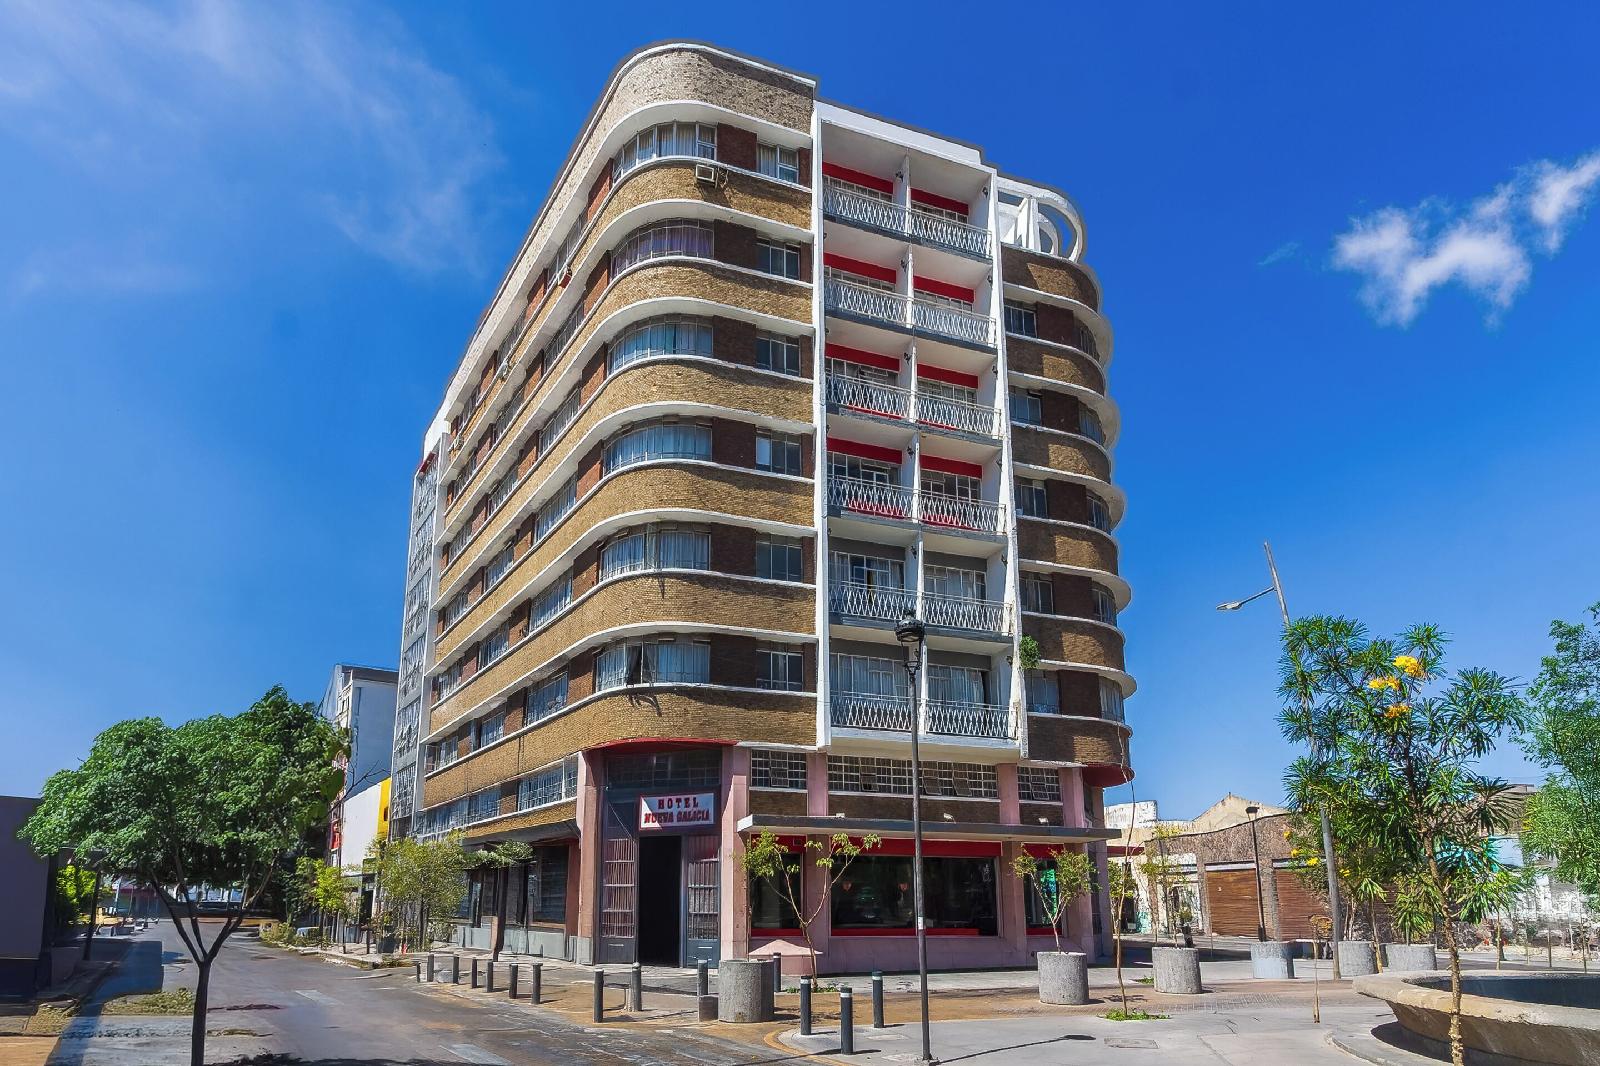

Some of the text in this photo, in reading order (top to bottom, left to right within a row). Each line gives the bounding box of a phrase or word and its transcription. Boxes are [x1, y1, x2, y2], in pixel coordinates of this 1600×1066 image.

[658, 797, 699, 809] HOTEL
[644, 810, 709, 823] NUEVA GALICIA
